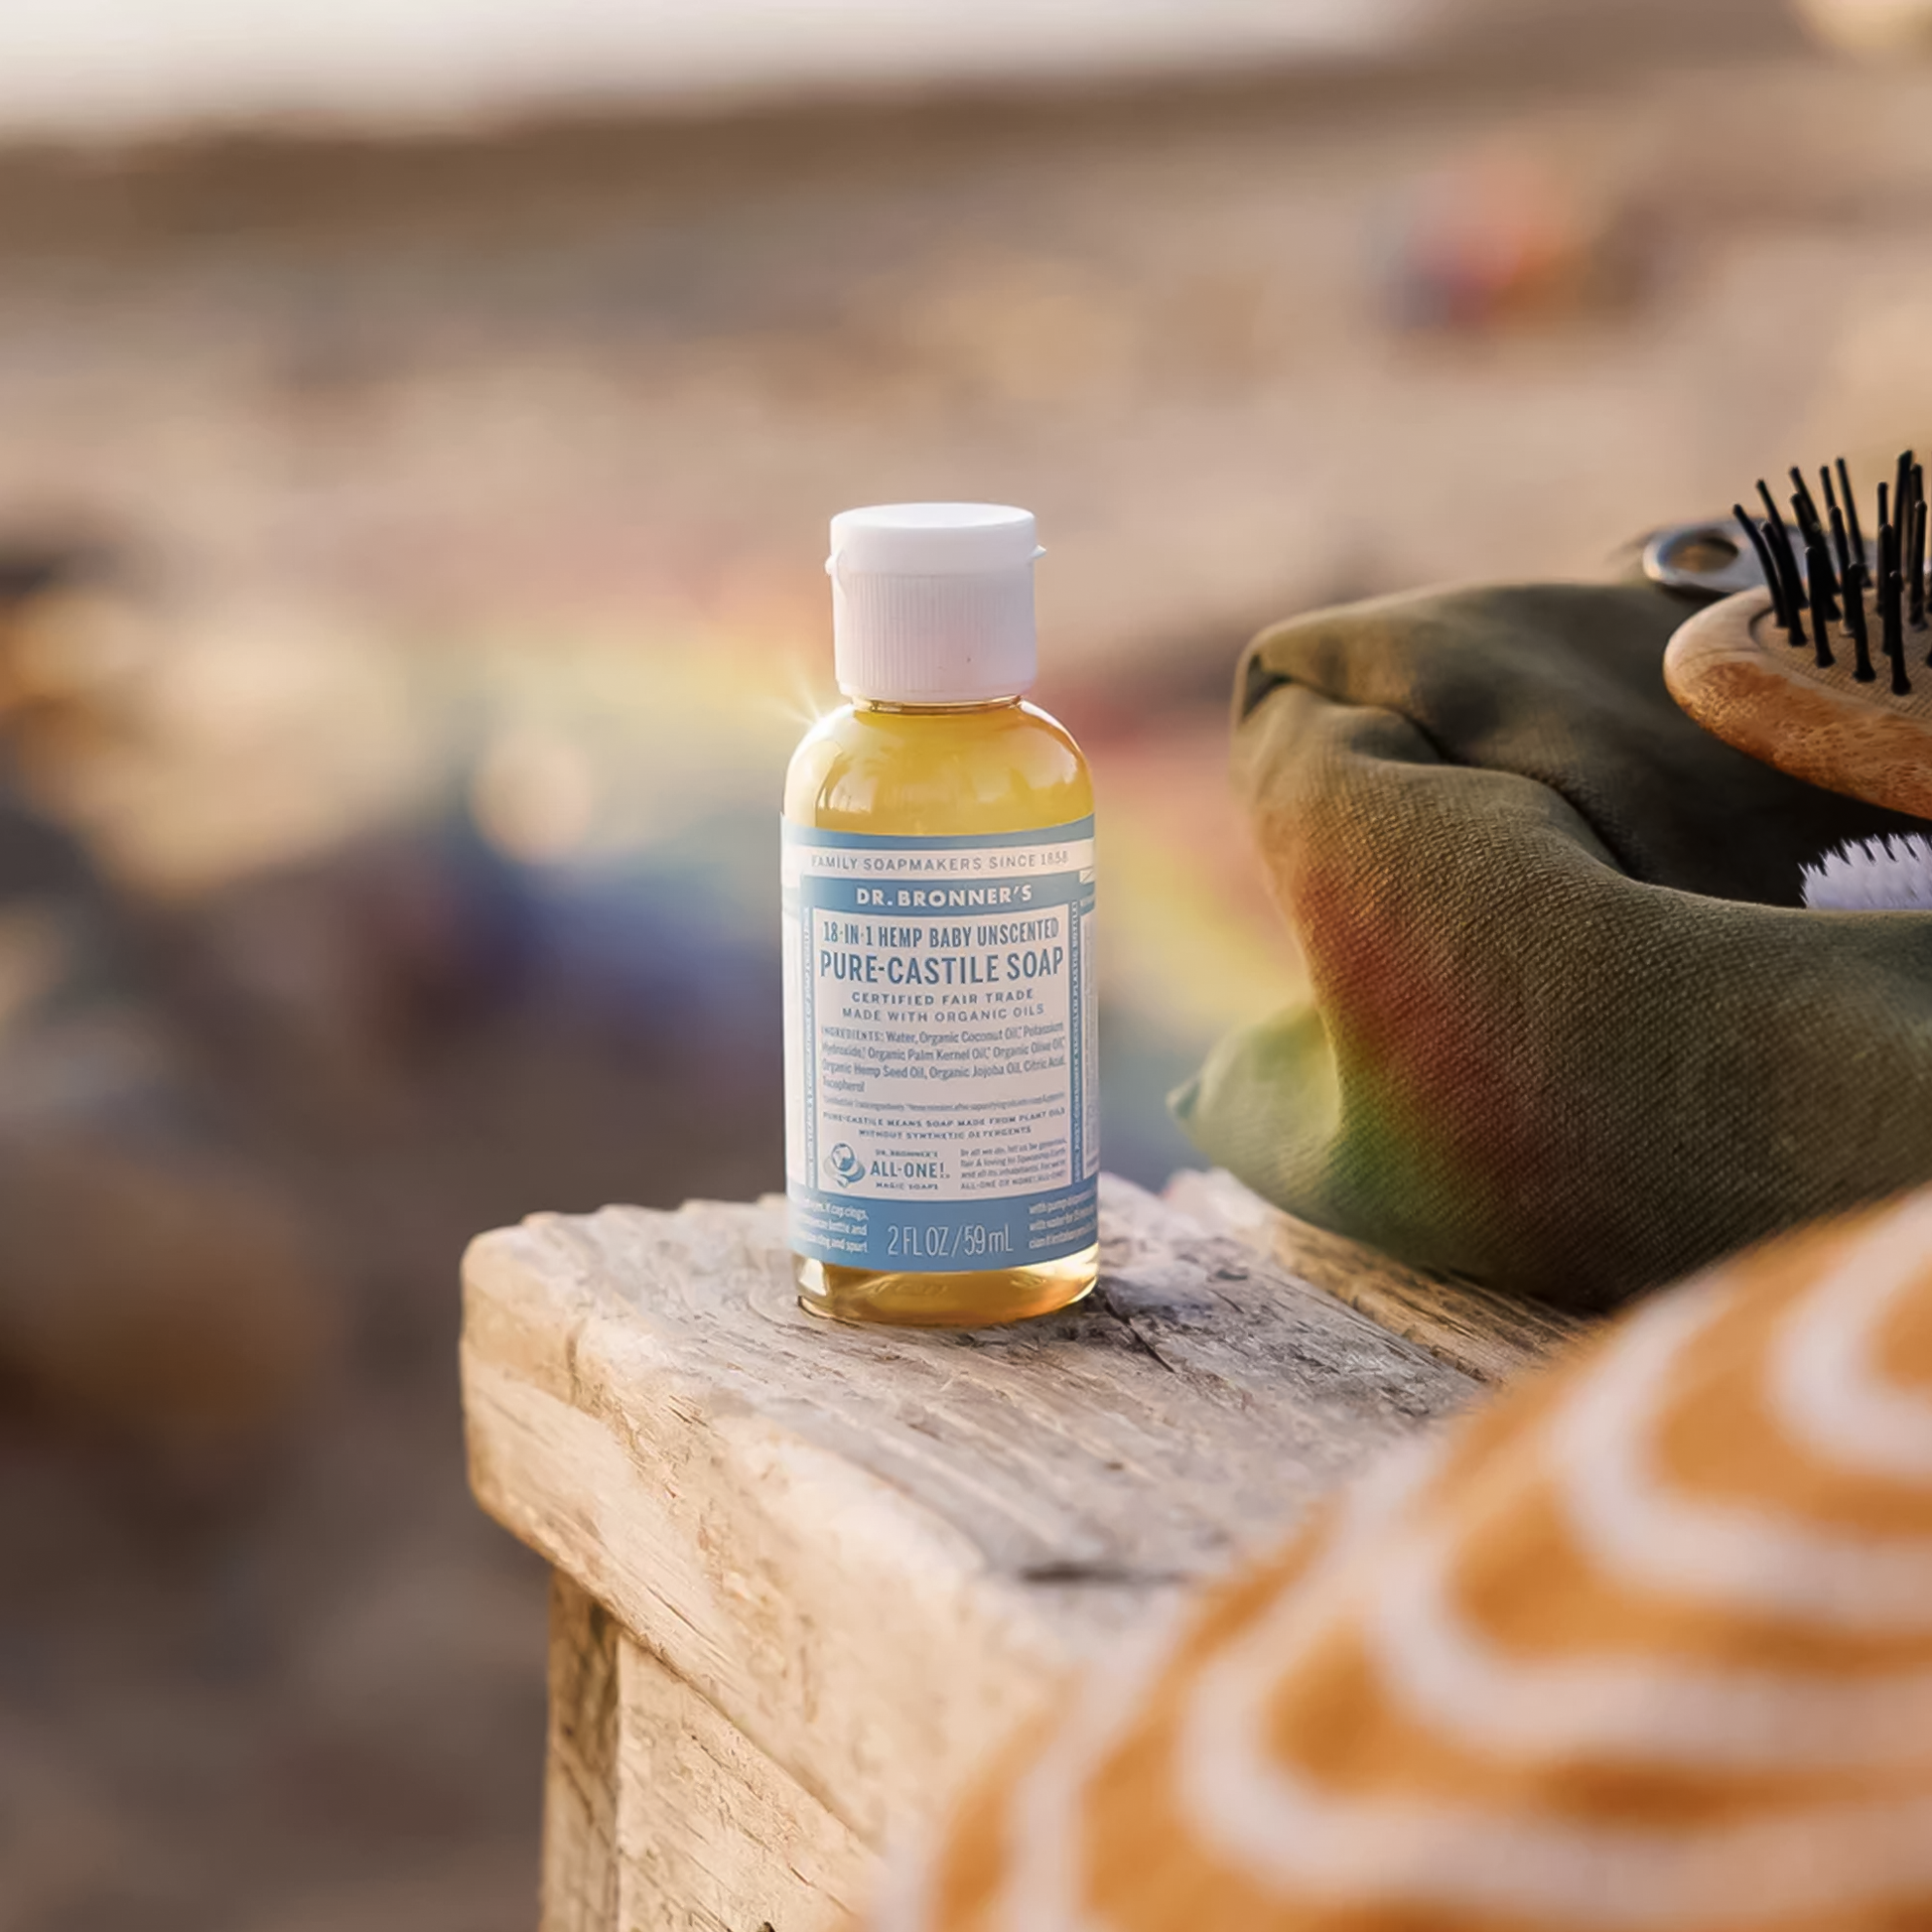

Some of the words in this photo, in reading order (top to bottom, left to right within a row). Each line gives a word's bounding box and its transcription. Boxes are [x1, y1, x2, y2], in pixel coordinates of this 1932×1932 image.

[811, 854, 858, 870] FAMILY
[863, 857, 982, 872] SOAPMAKERS
[989, 854, 1035, 870] SINCE
[1040, 850, 1069, 866] 1858
[856, 887, 894, 906] DR.
[897, 884, 1033, 908] BRONNER'S
[879, 925, 922, 948] HEMP
[929, 925, 972, 948] BABY
[977, 917, 1059, 947] UNSCENTED
[820, 950, 1000, 985] PURE-CASTILE
[1007, 946, 1064, 981] SOAP
[851, 991, 934, 1006] CERTIFIED
[942, 993, 978, 1006] FAIR
[986, 988, 1034, 1004] TRADE
[842, 1007, 882, 1022] MADE
[888, 1011, 928, 1023] WITH
[934, 1008, 1008, 1023] ORGANIC
[1013, 1004, 1044, 1020] OILS
[886, 1031, 918, 1044] Water,
[919, 1031, 959, 1046] Organic
[961, 1029, 1003, 1042] Coconut
[868, 1046, 905, 1062] Organic
[907, 1048, 934, 1060] Palm
[936, 1048, 970, 1060] Kernel
[993, 1043, 1030, 1059] Organic
[854, 1063, 882, 1078] Hemp
[883, 1065, 908, 1078] Seed
[929, 1065, 970, 1080] Organic
[972, 1064, 1005, 1079] Jojoba
[888, 1119, 922, 1128] MEANS
[957, 1117, 986, 1127] MADE
[989, 1115, 1017, 1126] FROM
[1019, 1111, 1046, 1123] PLANT
[858, 1129, 902, 1139] WITHOUT
[906, 1131, 965, 1140] SYNTHETIC
[968, 1125, 1032, 1140] DETERGENTS
[870, 1161, 944, 1178] ALL-ONE!
